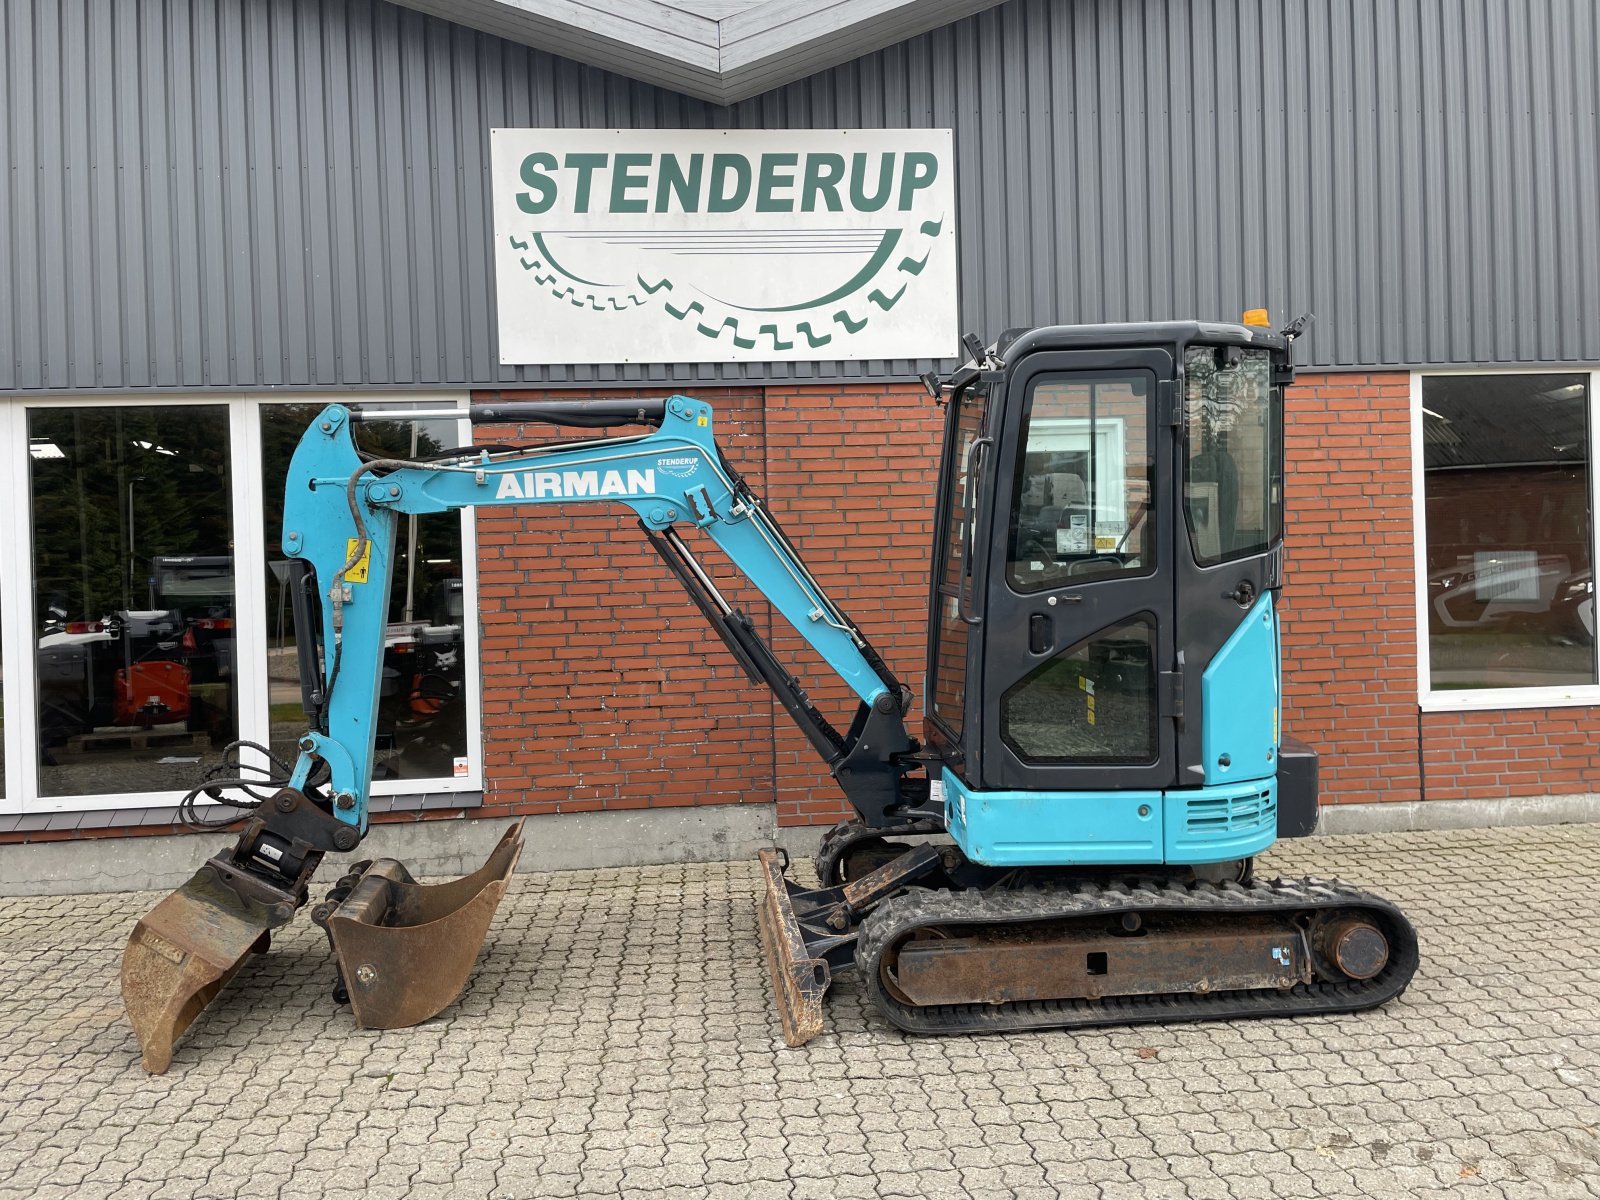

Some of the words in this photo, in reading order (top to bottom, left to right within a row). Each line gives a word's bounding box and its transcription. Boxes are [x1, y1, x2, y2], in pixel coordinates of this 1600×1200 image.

[515, 151, 938, 215] STENDERUP
[657, 457, 699, 466] STENDERUP
[495, 468, 656, 499] AIRMAN
